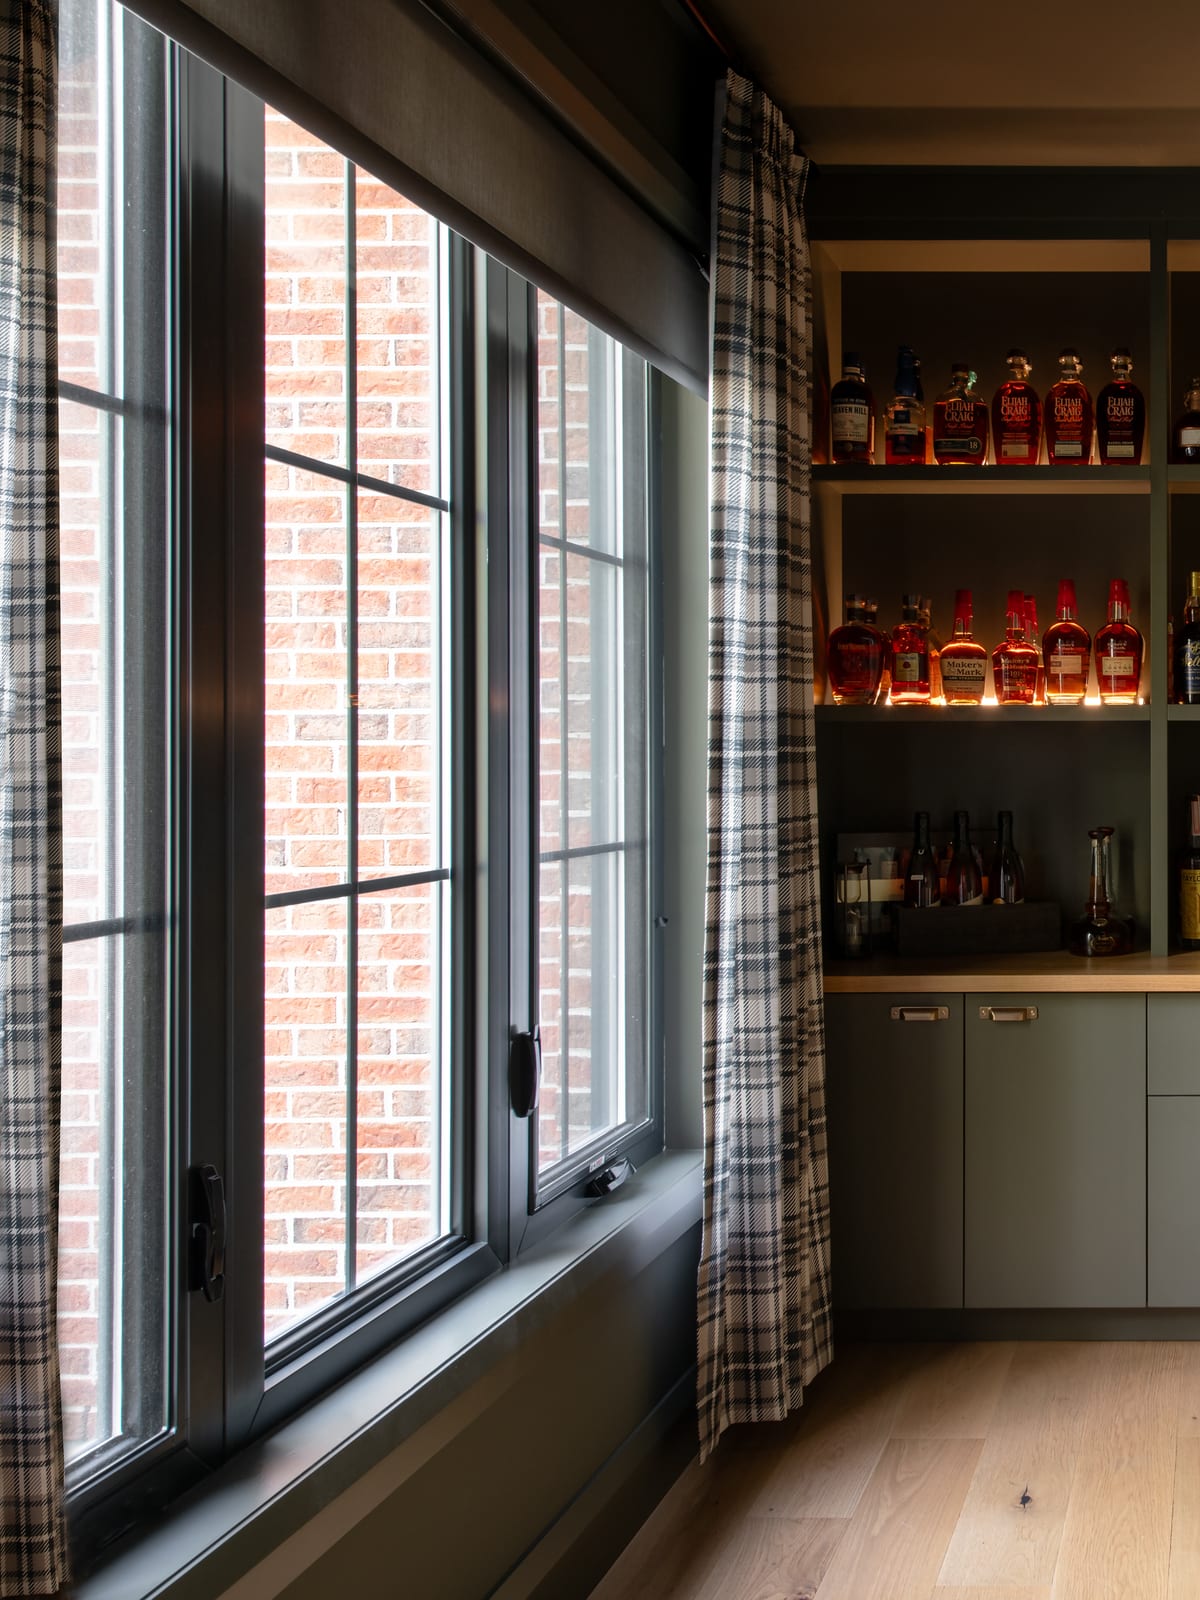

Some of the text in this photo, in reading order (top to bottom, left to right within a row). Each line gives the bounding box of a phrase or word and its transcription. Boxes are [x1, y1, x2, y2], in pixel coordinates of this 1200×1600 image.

[1001, 396, 1028, 406] ELIJAH
[1054, 397, 1081, 407] ELIJAH
[1107, 396, 1134, 407] ELIJAH
[1001, 405, 1028, 416] CRAIG
[1054, 406, 1081, 416] CRAIG
[1107, 406, 1134, 417] CRAIG
[944, 411, 974, 422] CRAIG
[969, 441, 978, 449] 18
[947, 661, 983, 669] Maker's
